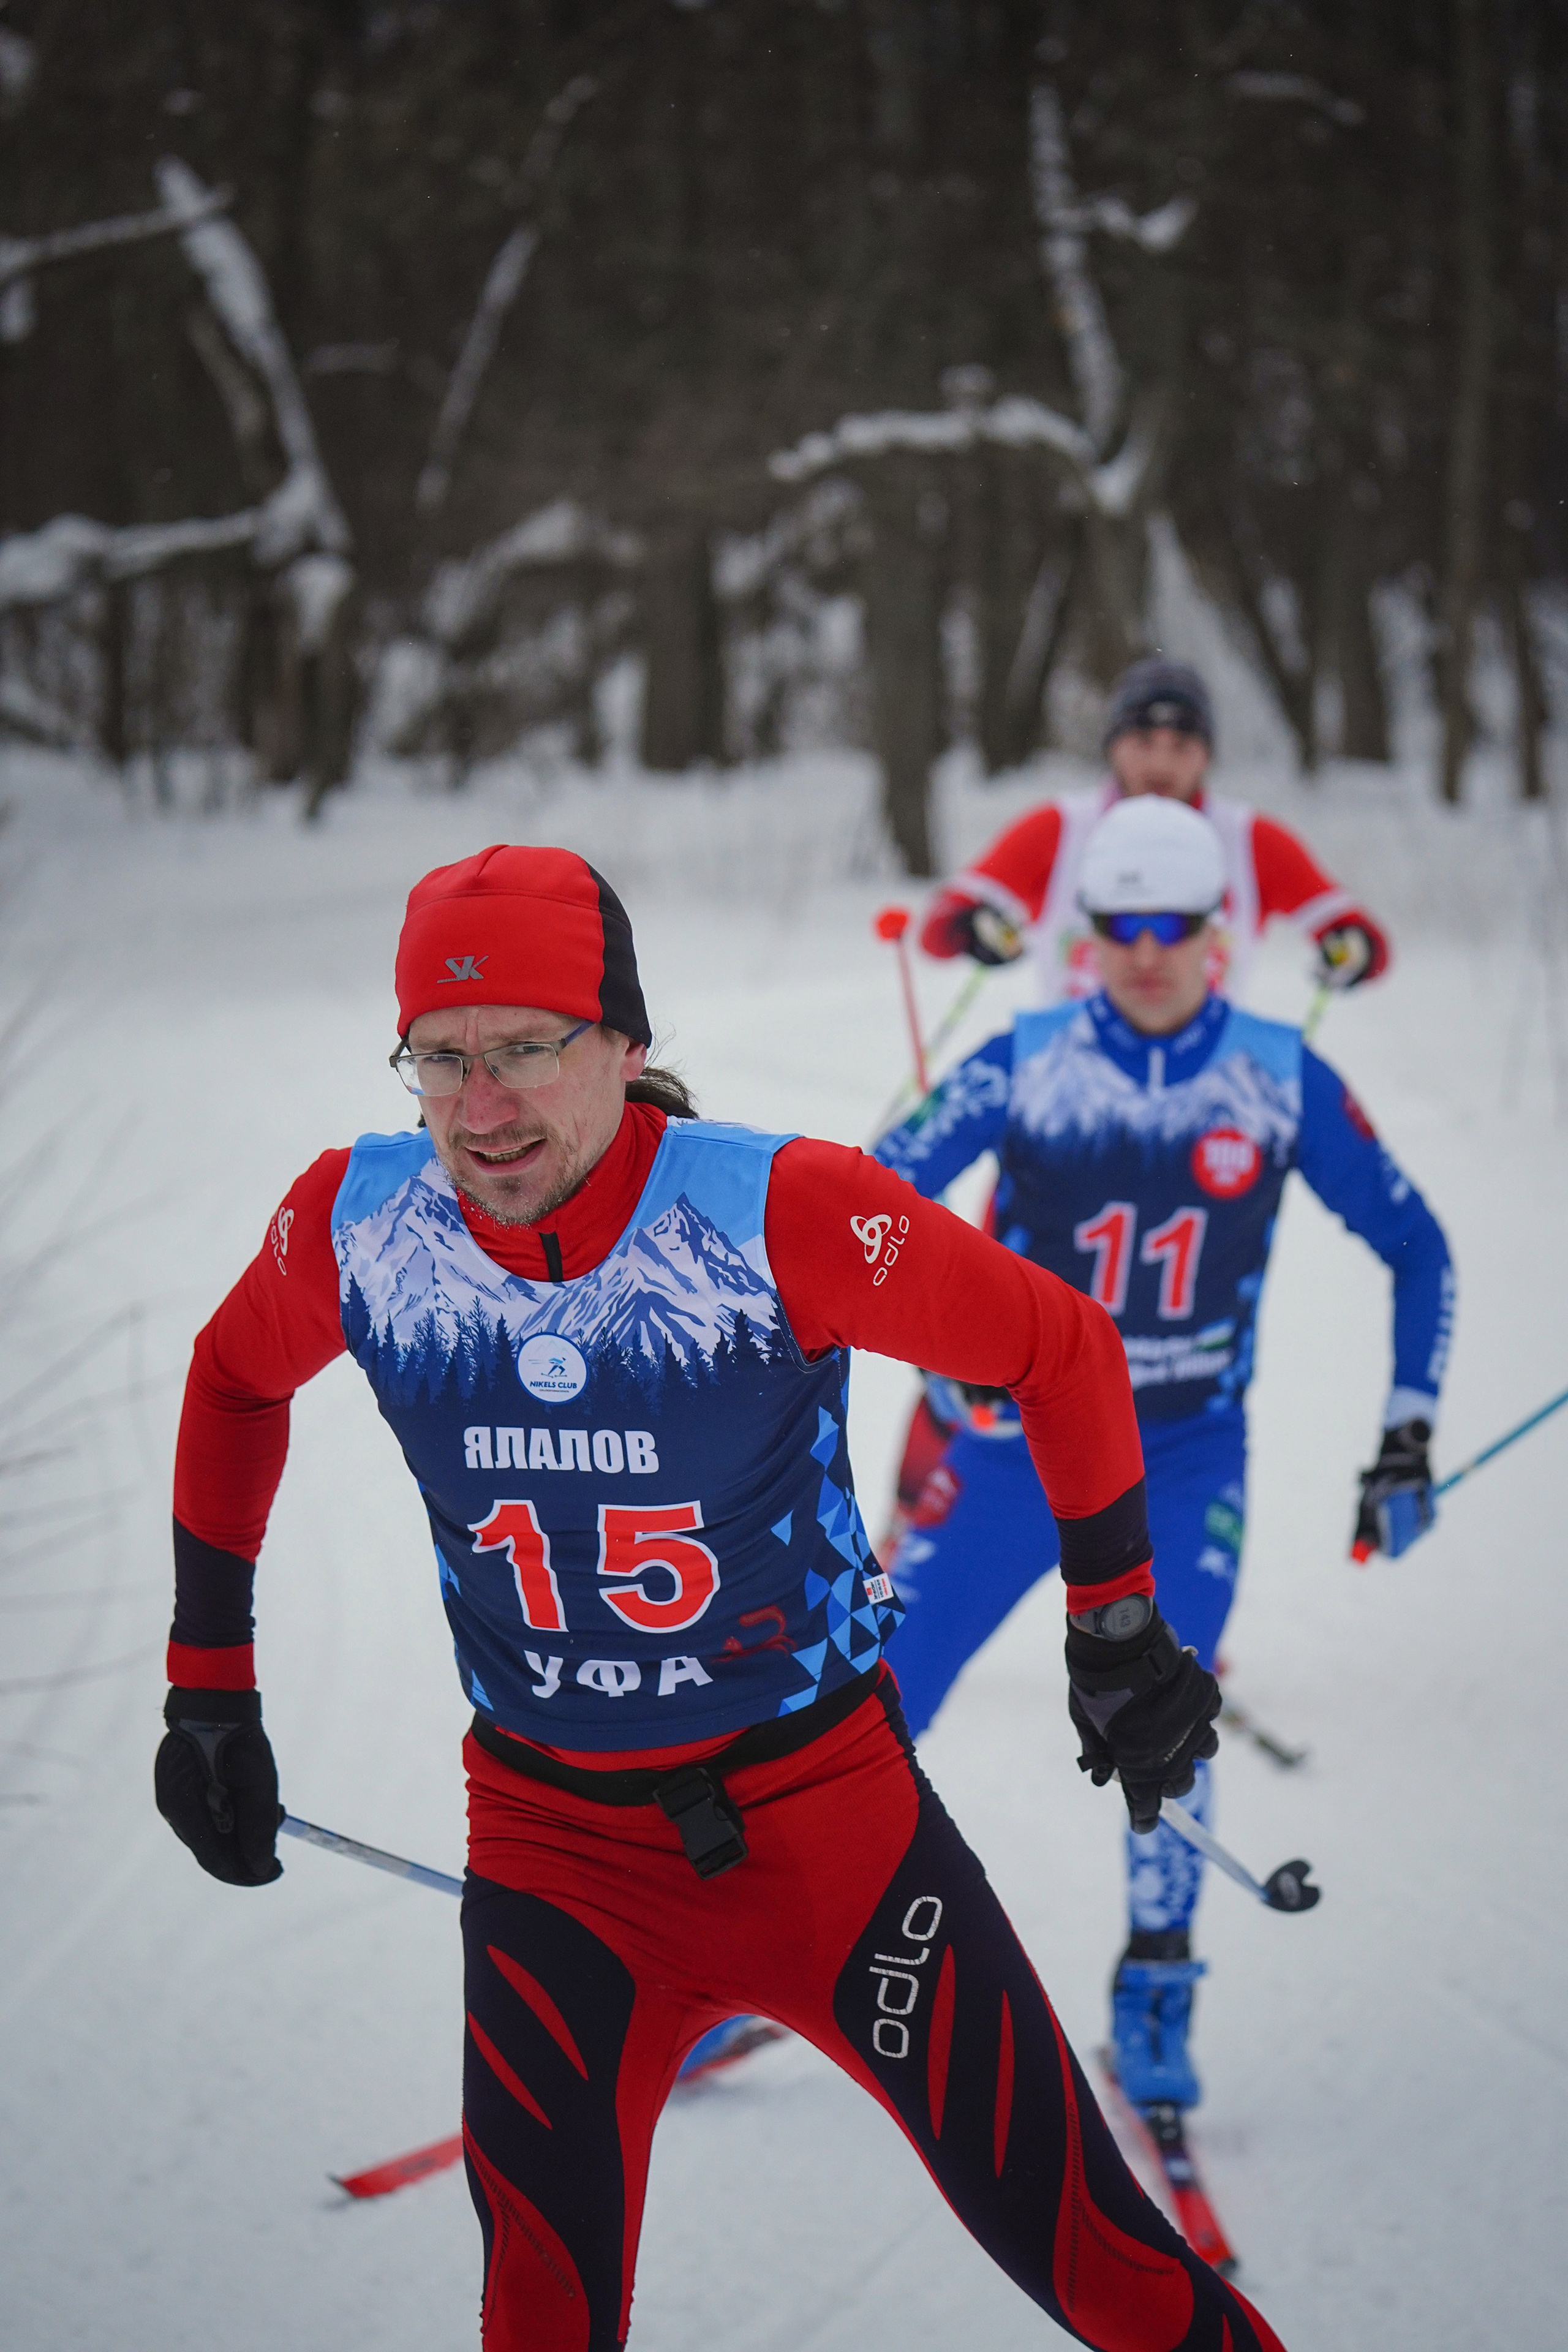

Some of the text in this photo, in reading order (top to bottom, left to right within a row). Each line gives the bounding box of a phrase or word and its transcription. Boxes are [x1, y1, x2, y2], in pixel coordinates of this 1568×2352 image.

[1074, 1202, 1207, 1319] 11
[463, 1426, 660, 1474] ЯЛАЛОВ
[467, 1499, 721, 1634] 15
[523, 1649, 714, 1698] УФА
